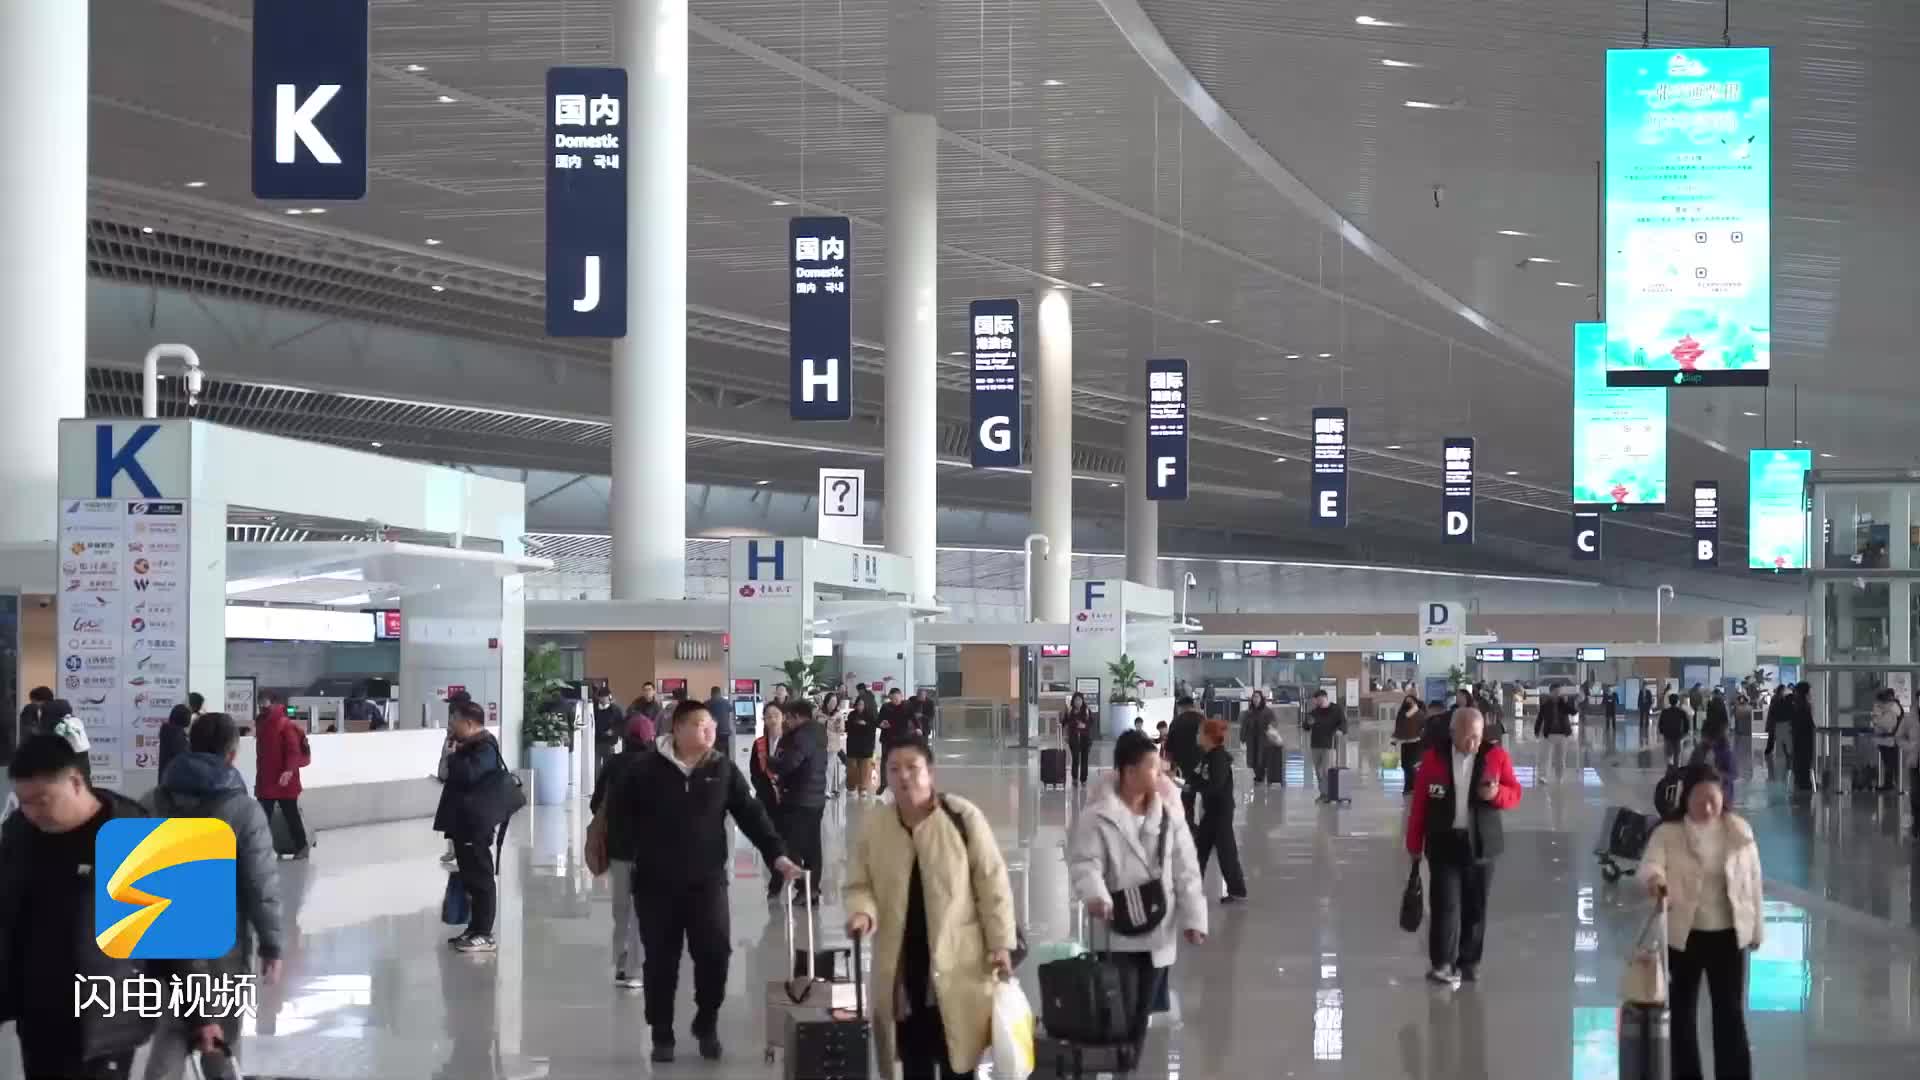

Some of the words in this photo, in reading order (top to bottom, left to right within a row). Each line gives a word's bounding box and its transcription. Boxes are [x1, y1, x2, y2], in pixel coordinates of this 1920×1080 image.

[275, 84, 341, 163] K
[556, 93, 619, 127] 国内
[555, 134, 619, 149] Domestic
[796, 236, 844, 261] 国内
[574, 255, 600, 313] J
[796, 265, 845, 278] Domestic
[975, 315, 1014, 335] 国际
[803, 359, 838, 402] H
[980, 416, 1011, 452] G
[95, 424, 162, 498] K
[1158, 457, 1177, 488] F
[1320, 490, 1338, 518] E
[1447, 511, 1469, 536] D
[1577, 530, 1595, 552] C
[1698, 539, 1714, 561] B
[749, 540, 784, 580] H
[1085, 581, 1105, 609] F
[1429, 603, 1448, 625] D
[1732, 617, 1748, 636] B
